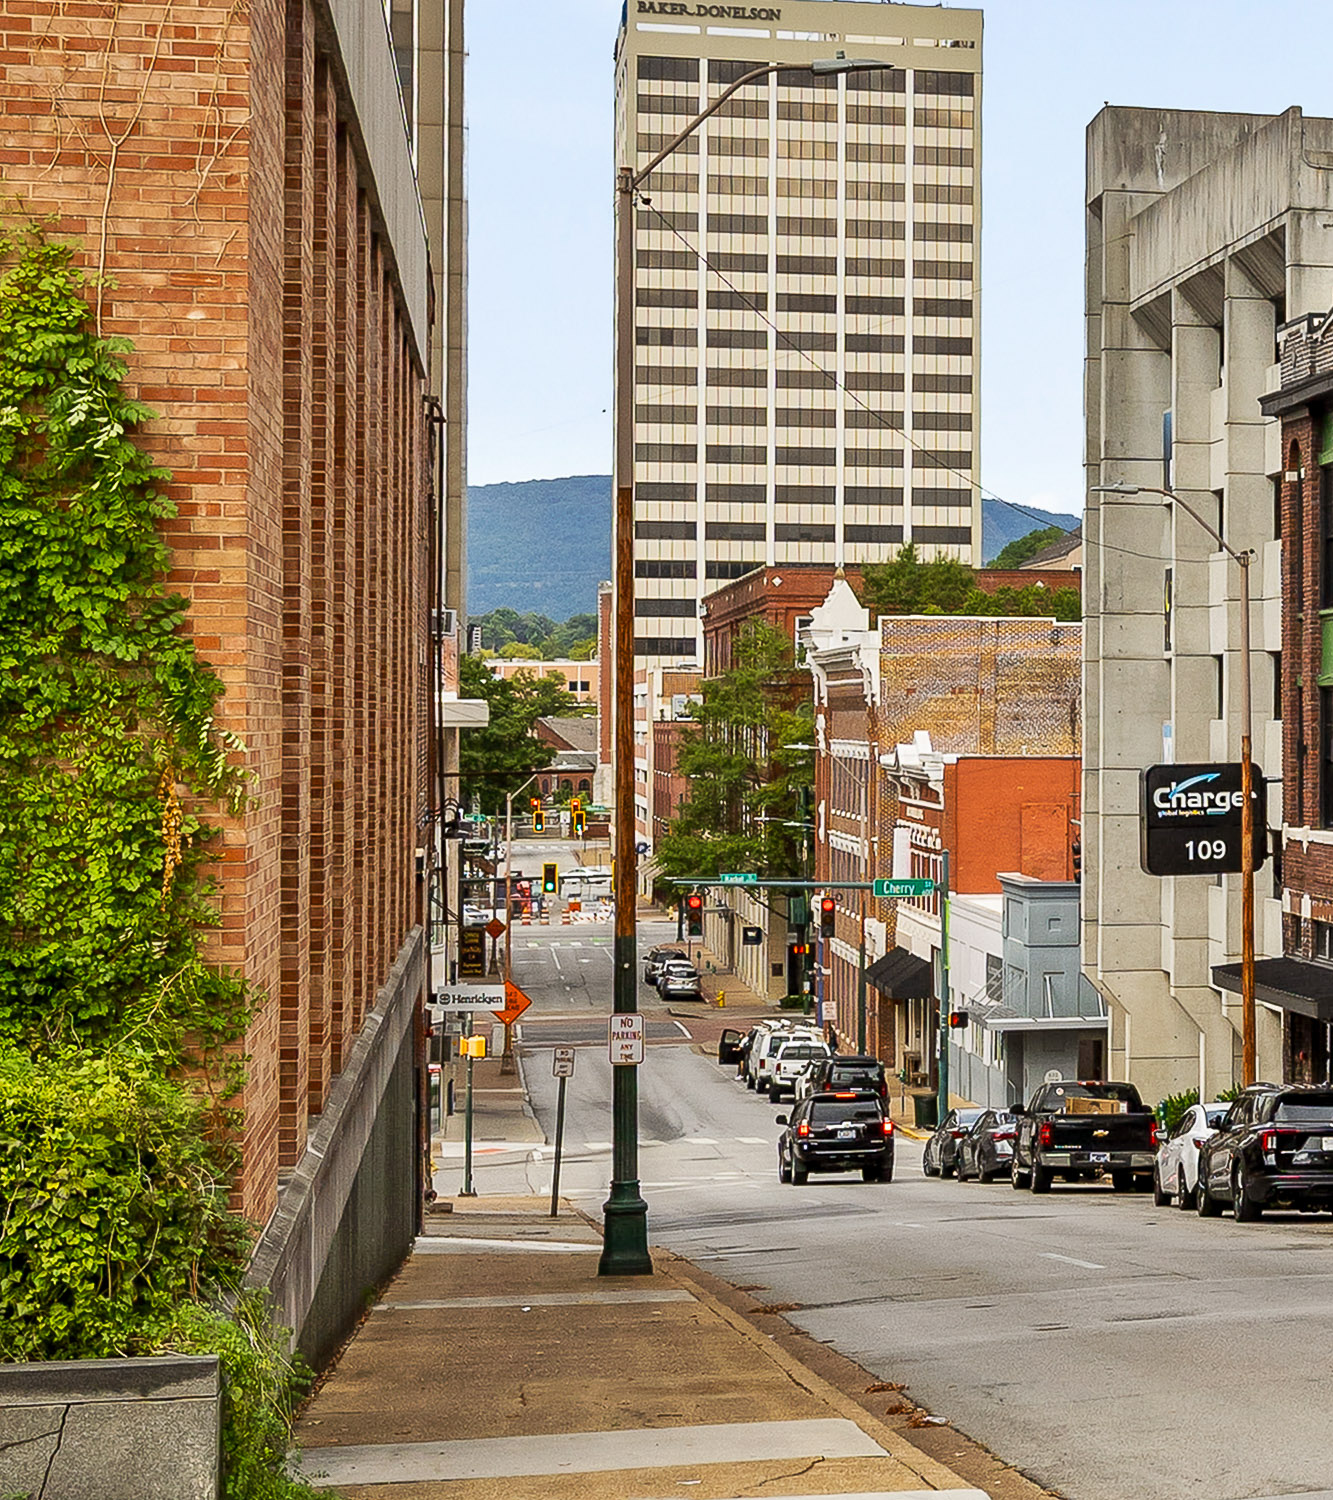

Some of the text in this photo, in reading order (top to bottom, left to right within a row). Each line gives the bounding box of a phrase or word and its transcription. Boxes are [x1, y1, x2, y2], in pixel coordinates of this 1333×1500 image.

[637, 0, 781, 21] BAKER DONELSON
[1153, 782, 1257, 813] Charge
[1185, 840, 1226, 860] 109
[883, 880, 915, 895] Cherry
[620, 1018, 633, 1028] NO
[612, 1030, 641, 1041] PARKING
